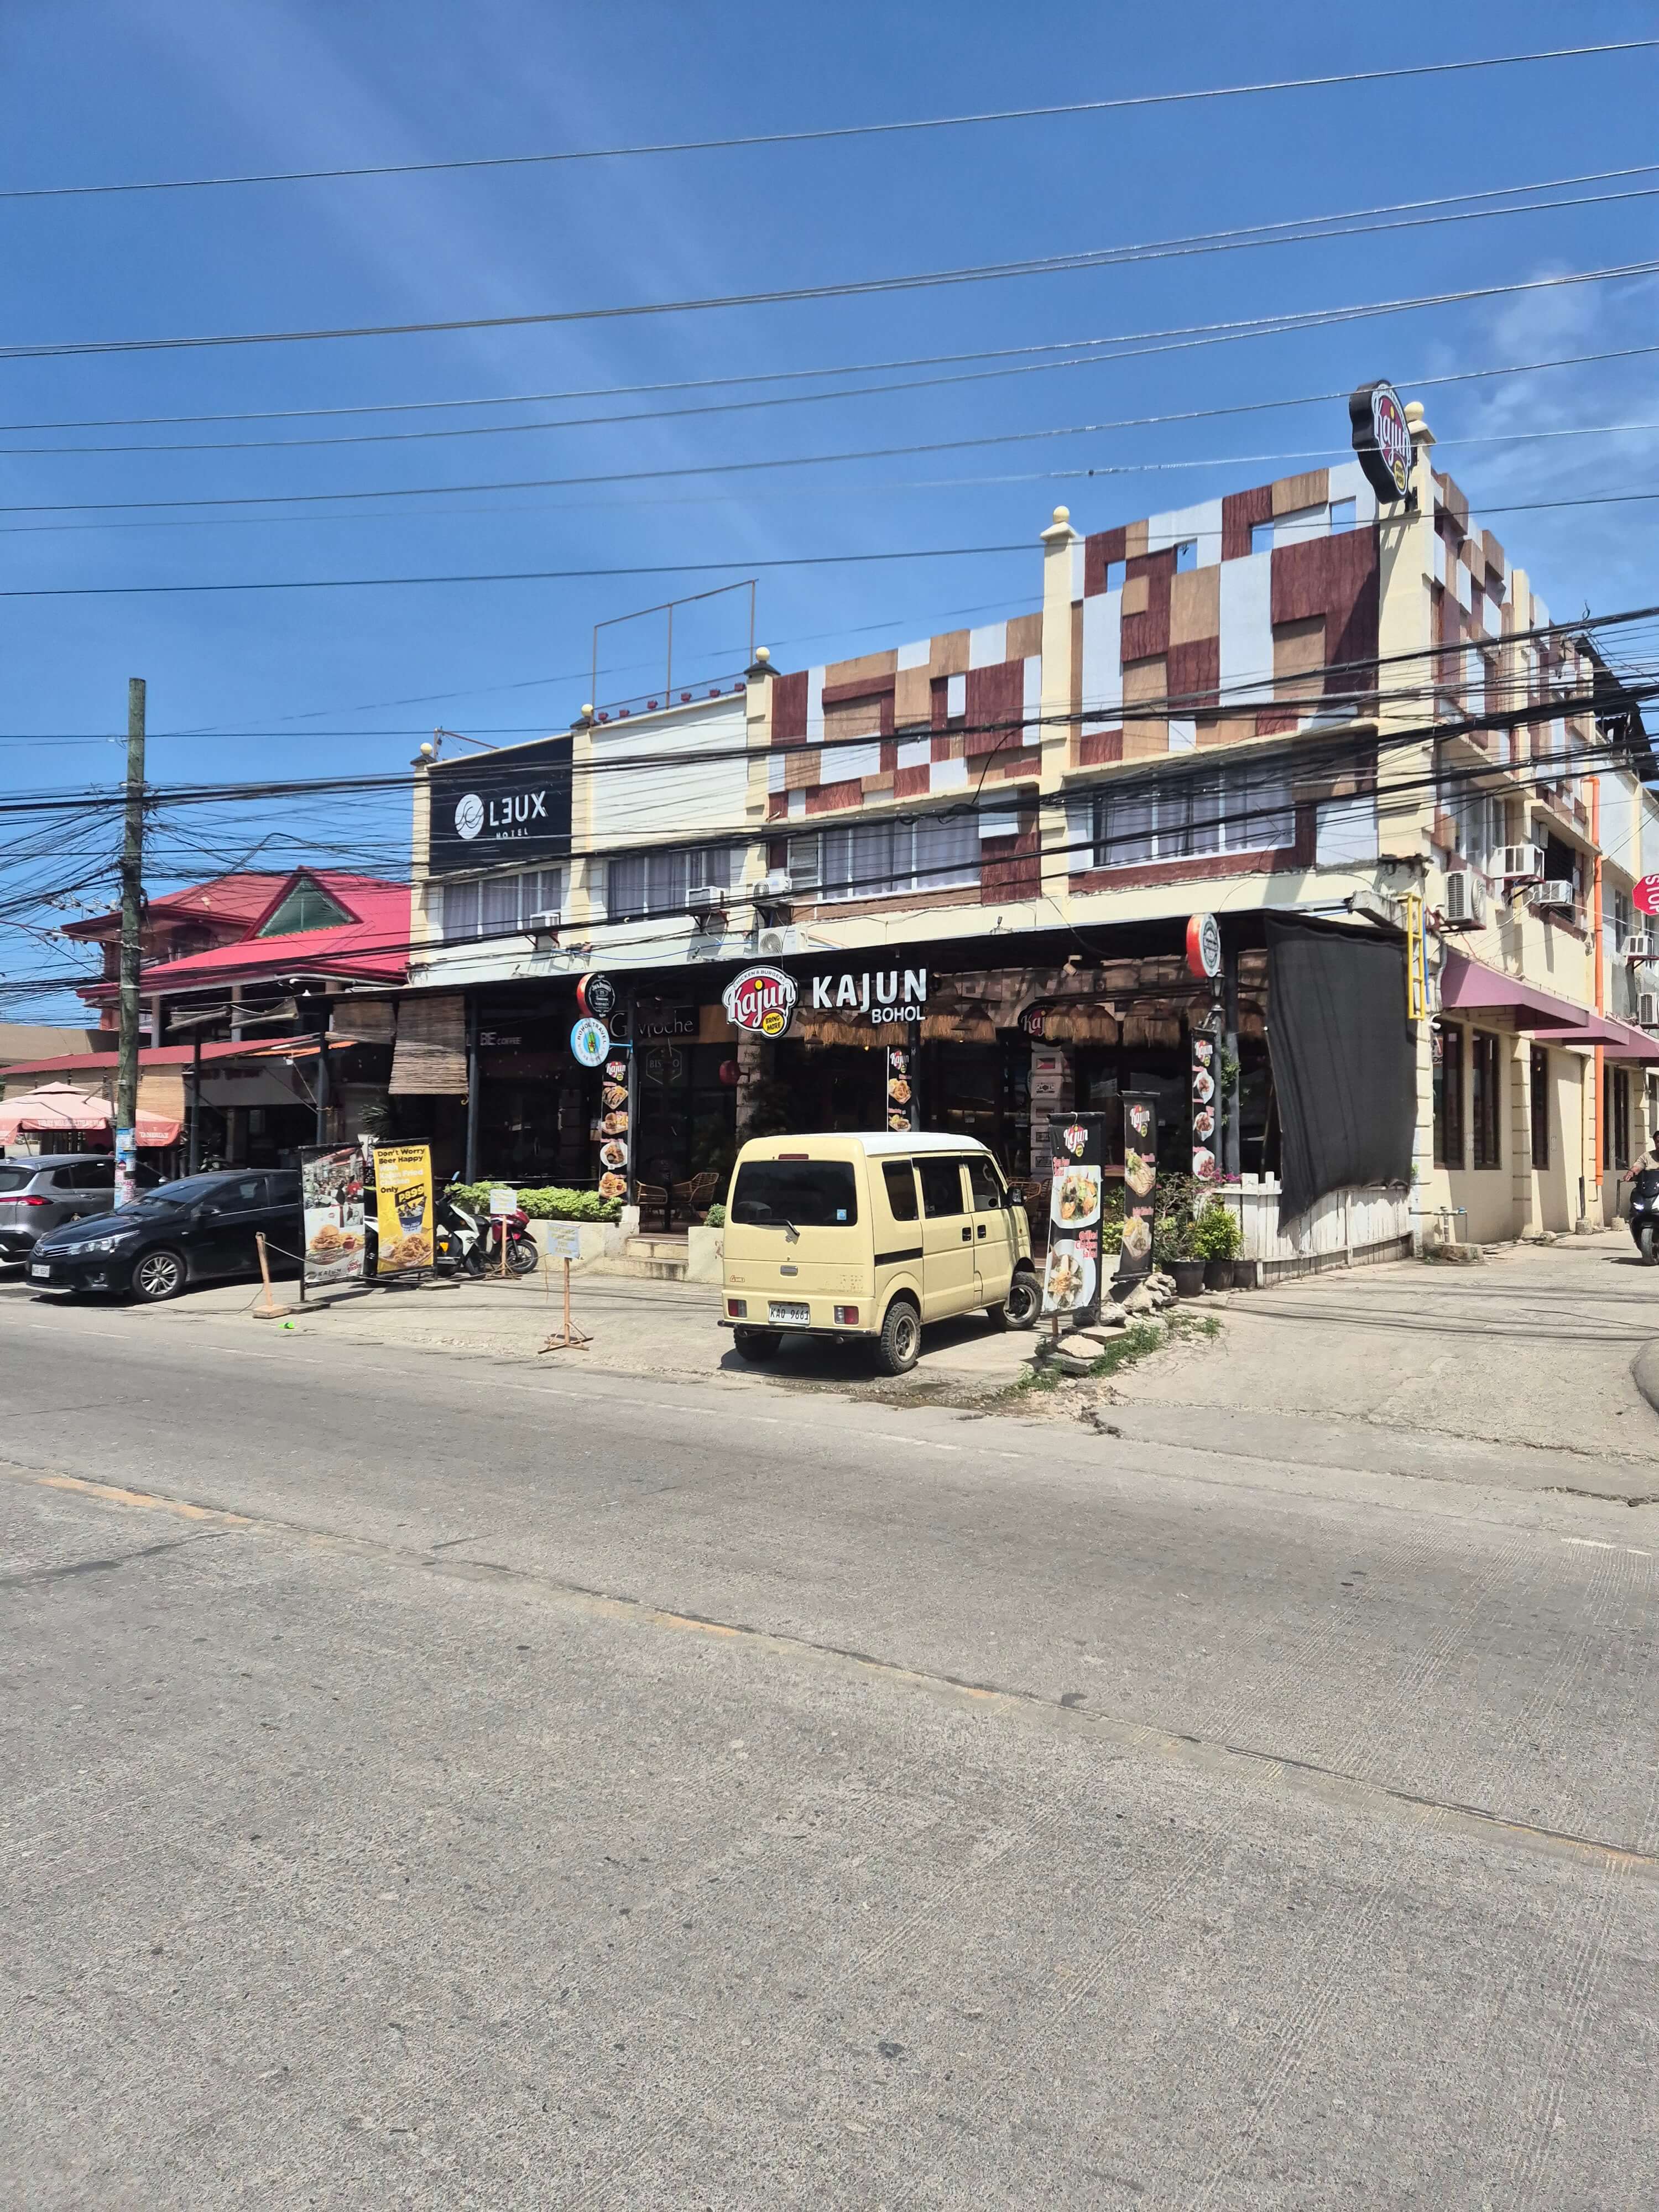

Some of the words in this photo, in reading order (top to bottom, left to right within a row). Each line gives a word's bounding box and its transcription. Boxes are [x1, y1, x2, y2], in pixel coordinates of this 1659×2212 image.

[1372, 393, 1411, 467] Kajun
[496, 828, 528, 839] HOTEL
[733, 971, 755, 988] CHICKEN
[760, 969, 786, 984] BURGERS
[813, 969, 926, 1013] KAJUN
[724, 979, 796, 1028] Kajun
[765, 1015, 780, 1024] BRING
[872, 1006, 926, 1024] BOHOL
[577, 1022, 592, 1040] BOHOL
[592, 1022, 607, 1044] TRAVEL
[606, 1061, 626, 1078] Kajun
[650, 1059, 679, 1068] BISO
[890, 1051, 910, 1070] Kajun
[1130, 1106, 1150, 1133] Kajun
[790, 1309, 808, 1321] 9661
